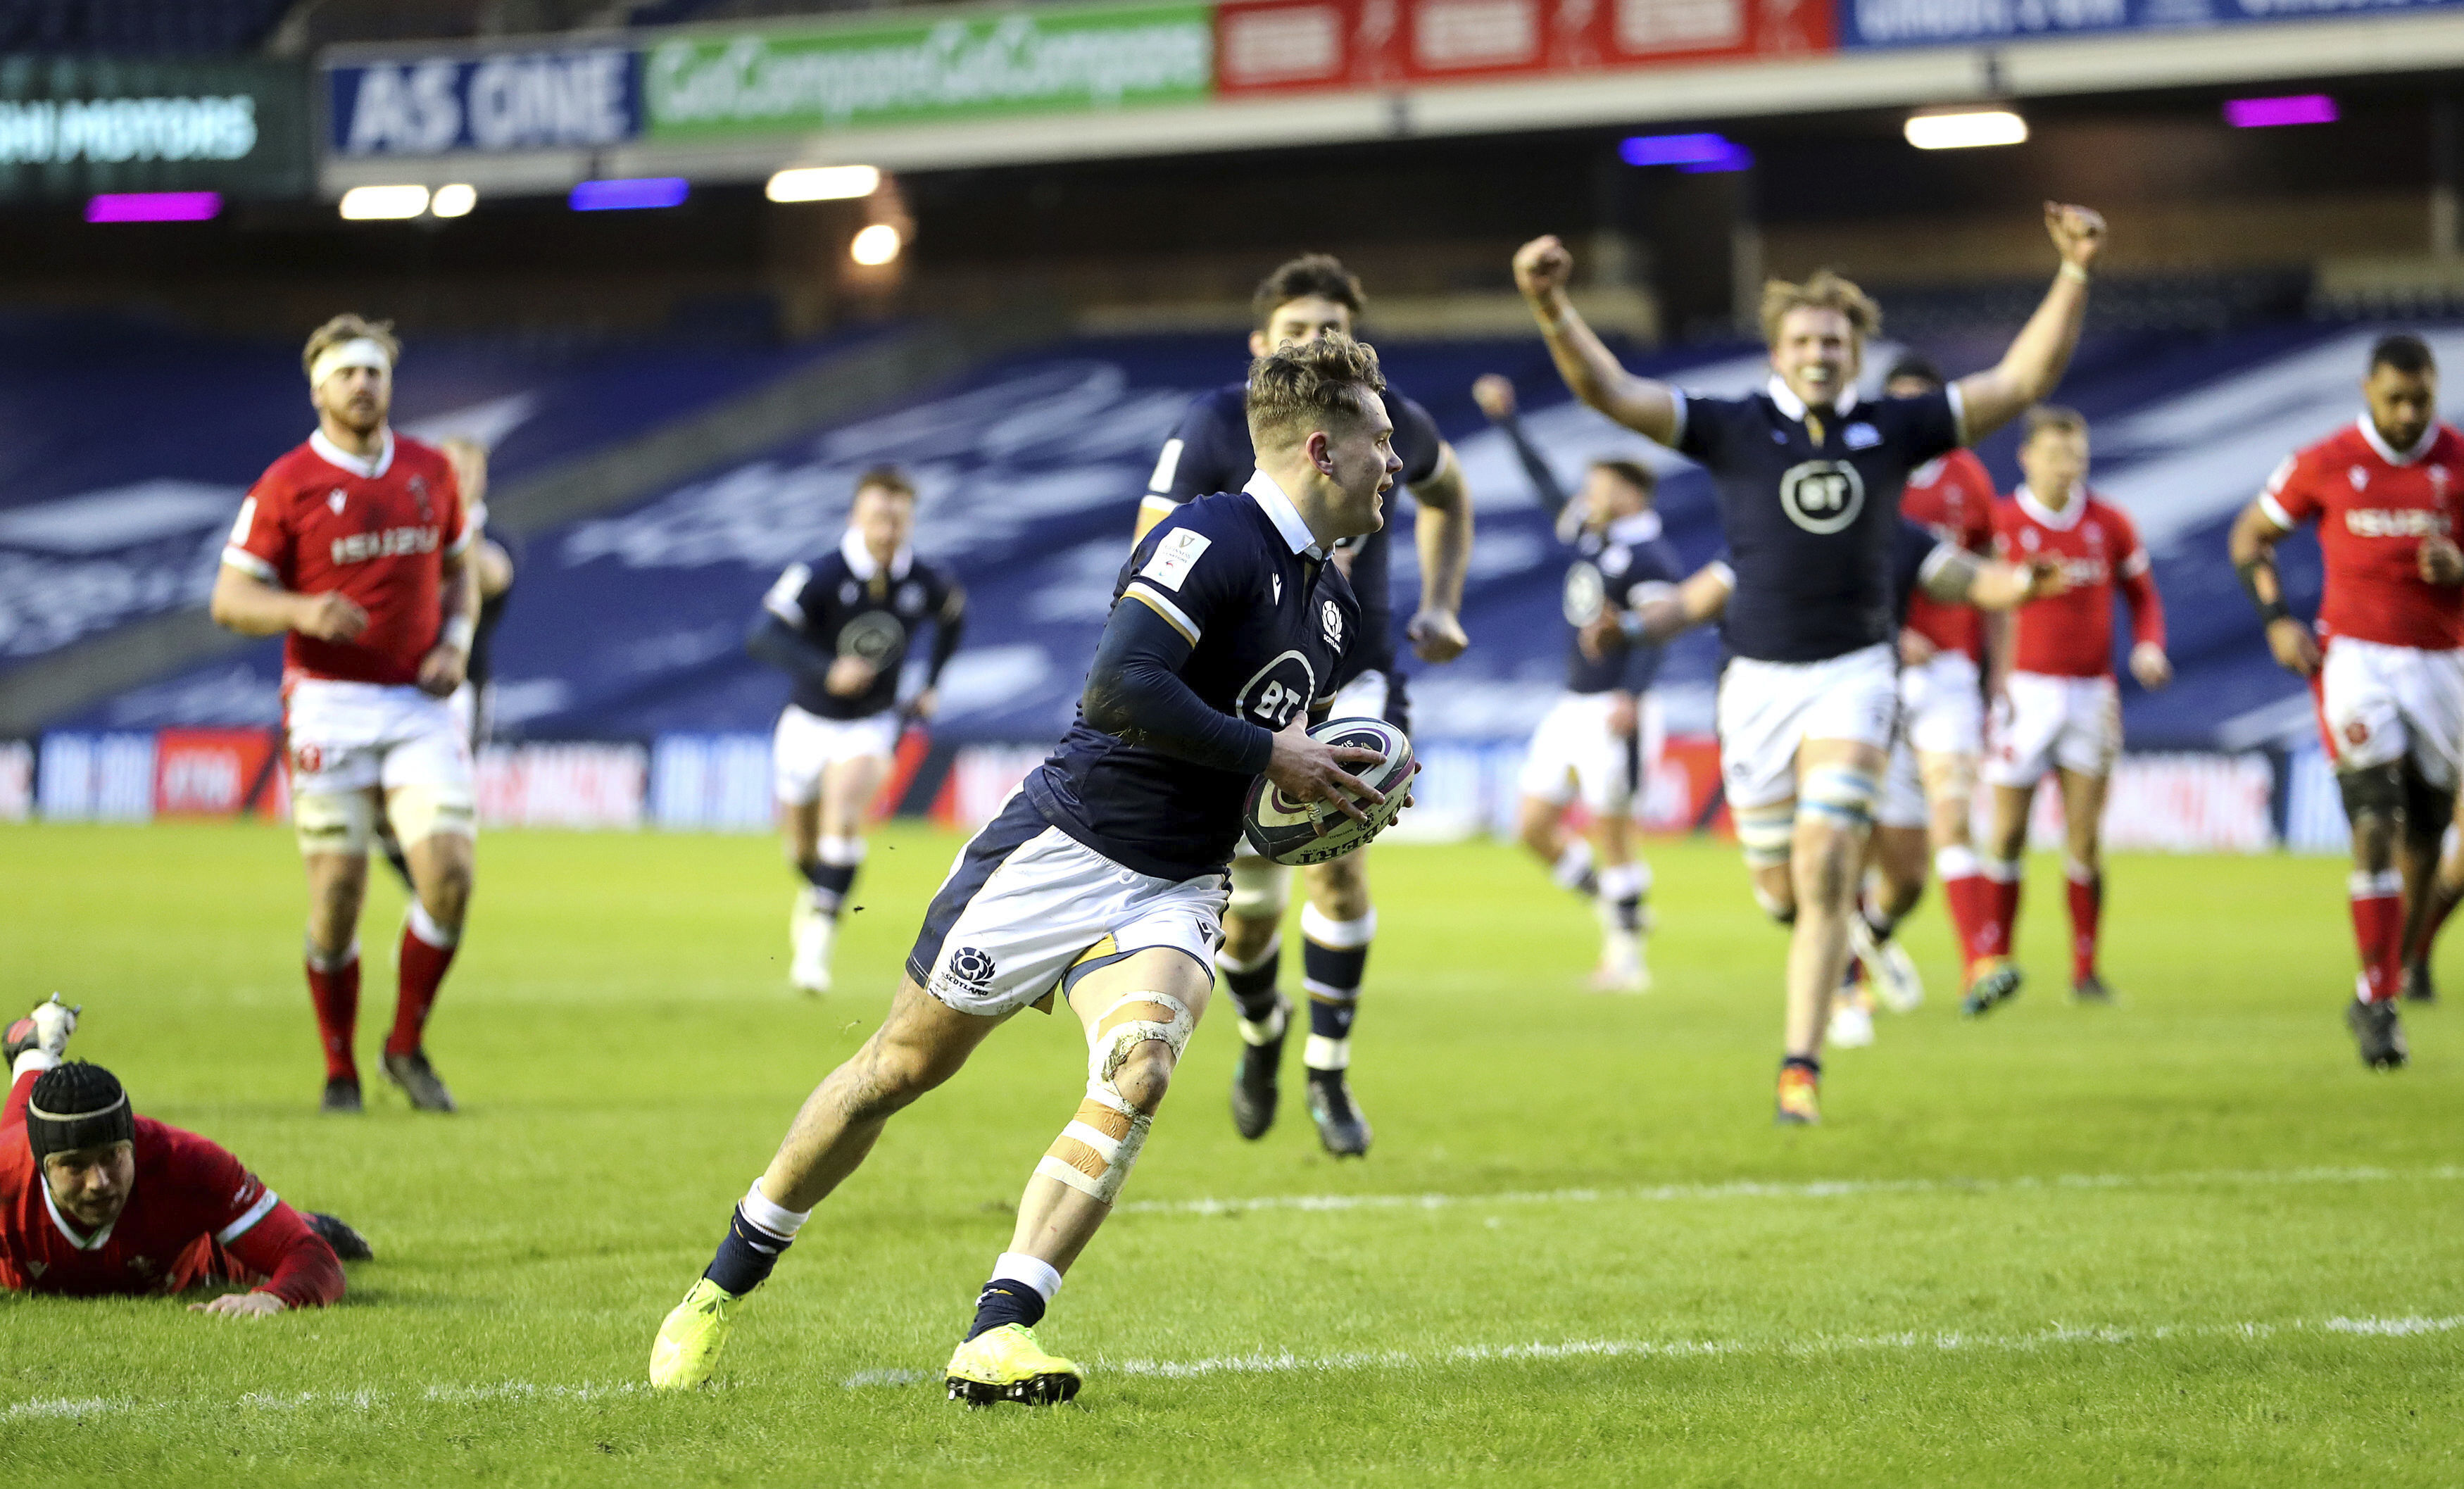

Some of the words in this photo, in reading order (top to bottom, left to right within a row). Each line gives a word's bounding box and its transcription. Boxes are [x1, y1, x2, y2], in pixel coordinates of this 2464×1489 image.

[346, 61, 463, 154] AS
[467, 46, 631, 149] ONE
[58, 94, 258, 162] MOTORS
[1799, 475, 1847, 511] BT
[331, 526, 439, 565] ISUZU
[1253, 679, 1302, 727] BT
[944, 974, 988, 996] SCOTLAND
